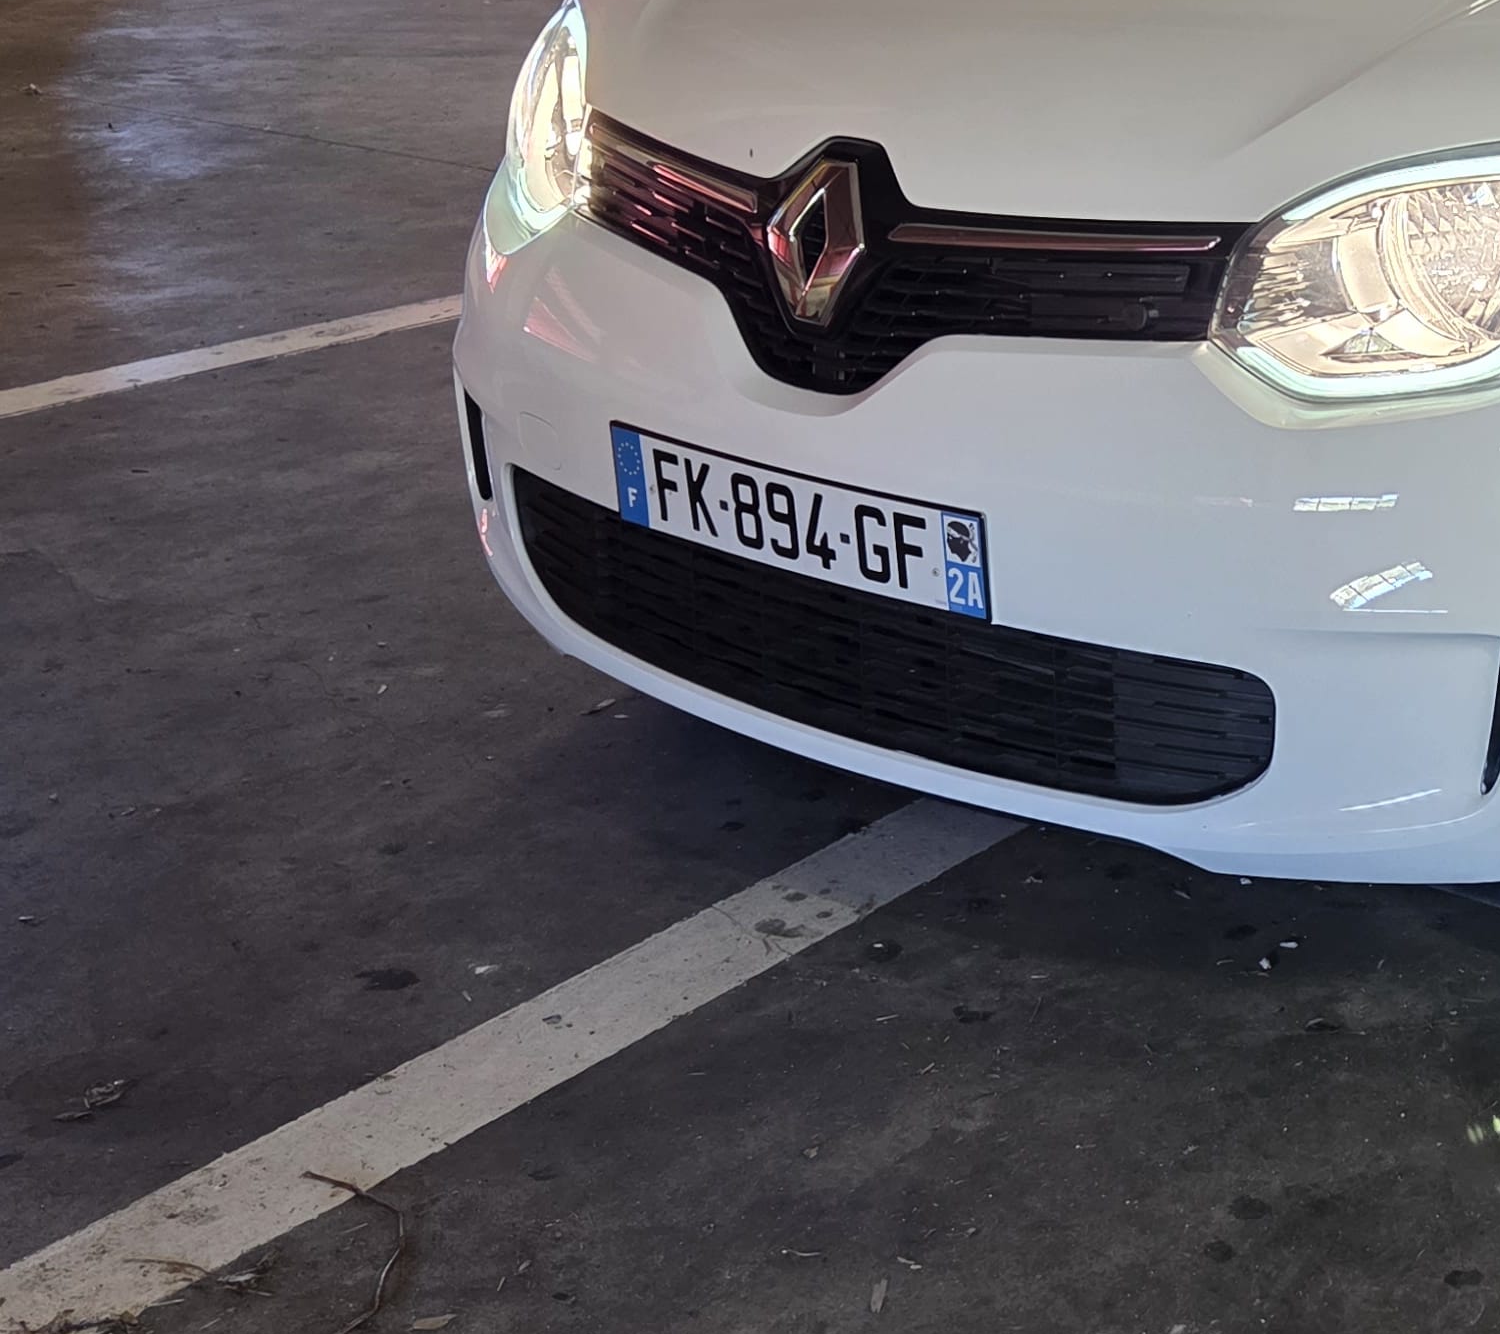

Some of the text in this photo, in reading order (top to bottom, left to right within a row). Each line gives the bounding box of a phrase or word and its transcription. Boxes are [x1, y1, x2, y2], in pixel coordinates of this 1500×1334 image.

[627, 487, 637, 508] F
[652, 448, 927, 589] FK-894-GF
[947, 567, 984, 609] 2A
